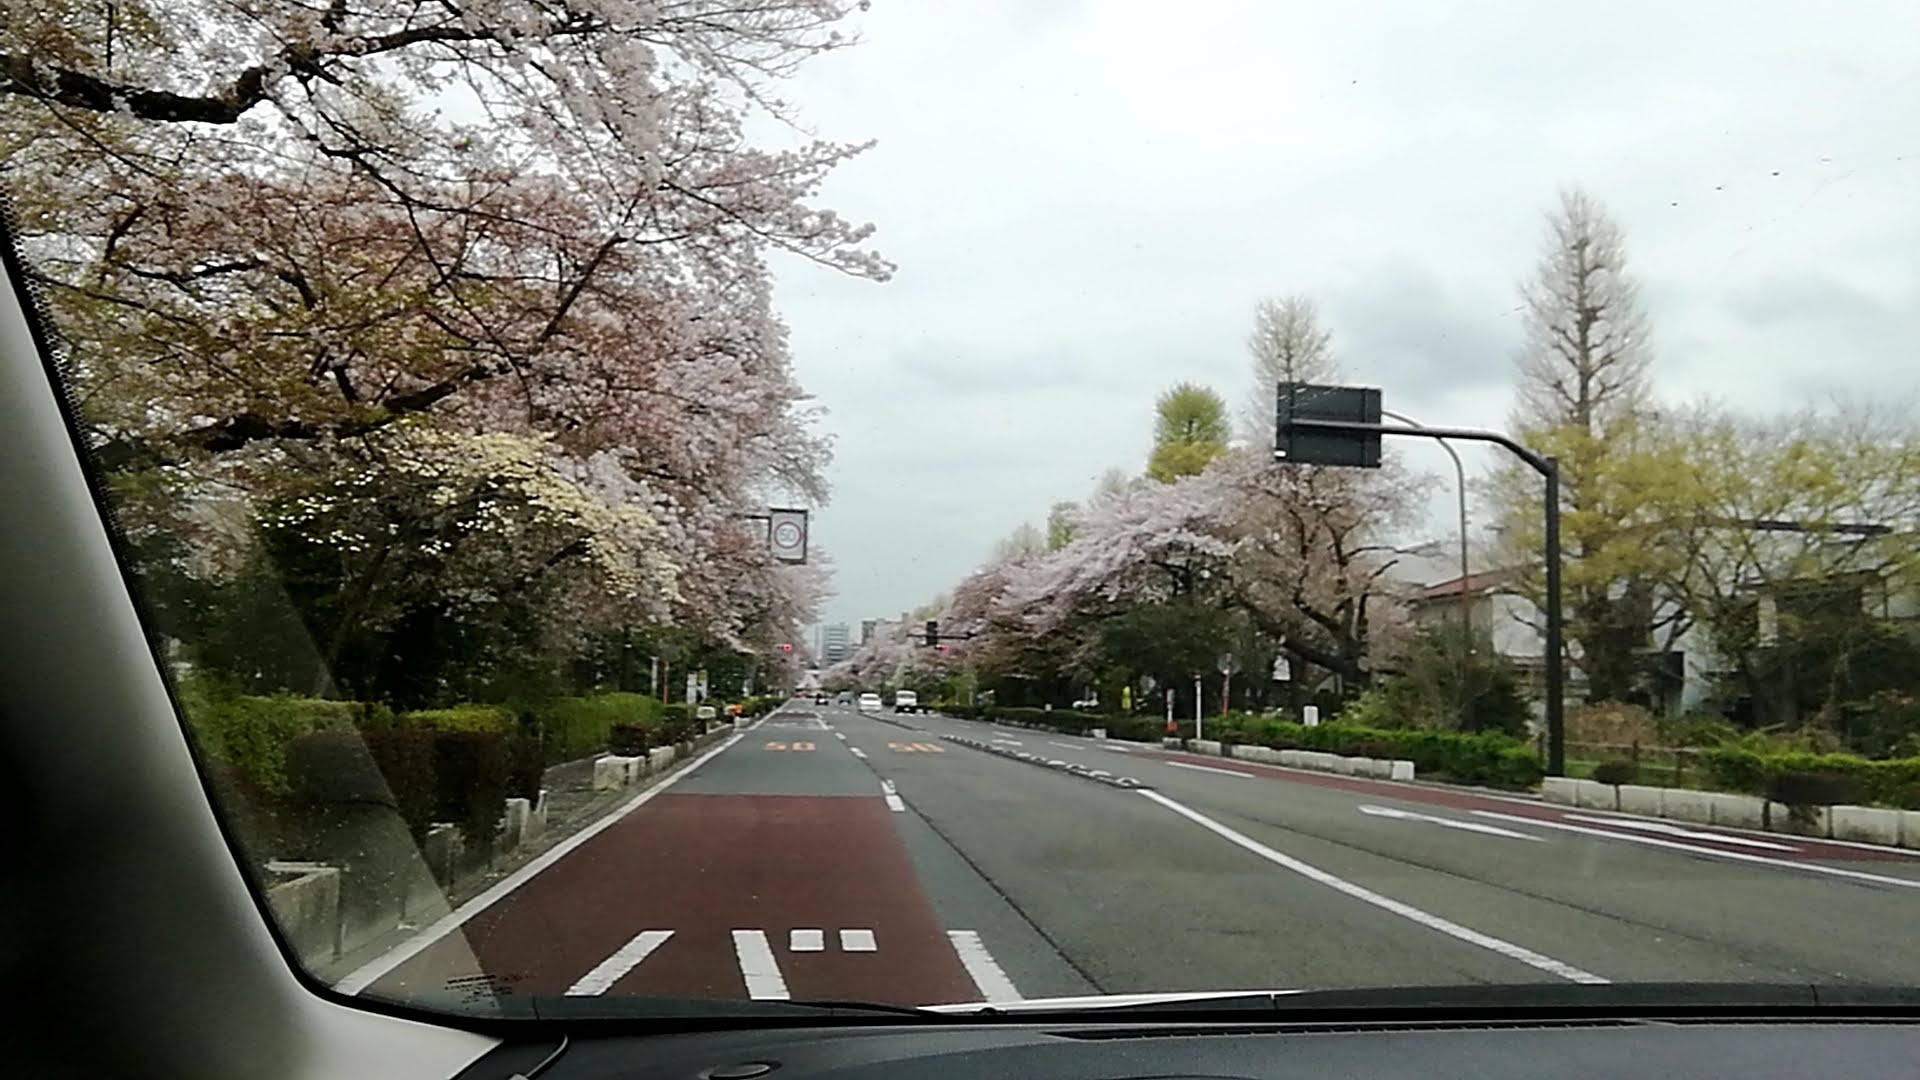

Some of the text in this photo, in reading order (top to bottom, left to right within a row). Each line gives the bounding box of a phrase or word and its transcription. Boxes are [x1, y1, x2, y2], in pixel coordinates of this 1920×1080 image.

[779, 528, 797, 542] 50
[764, 741, 816, 752] 50
[887, 741, 945, 753] 50
